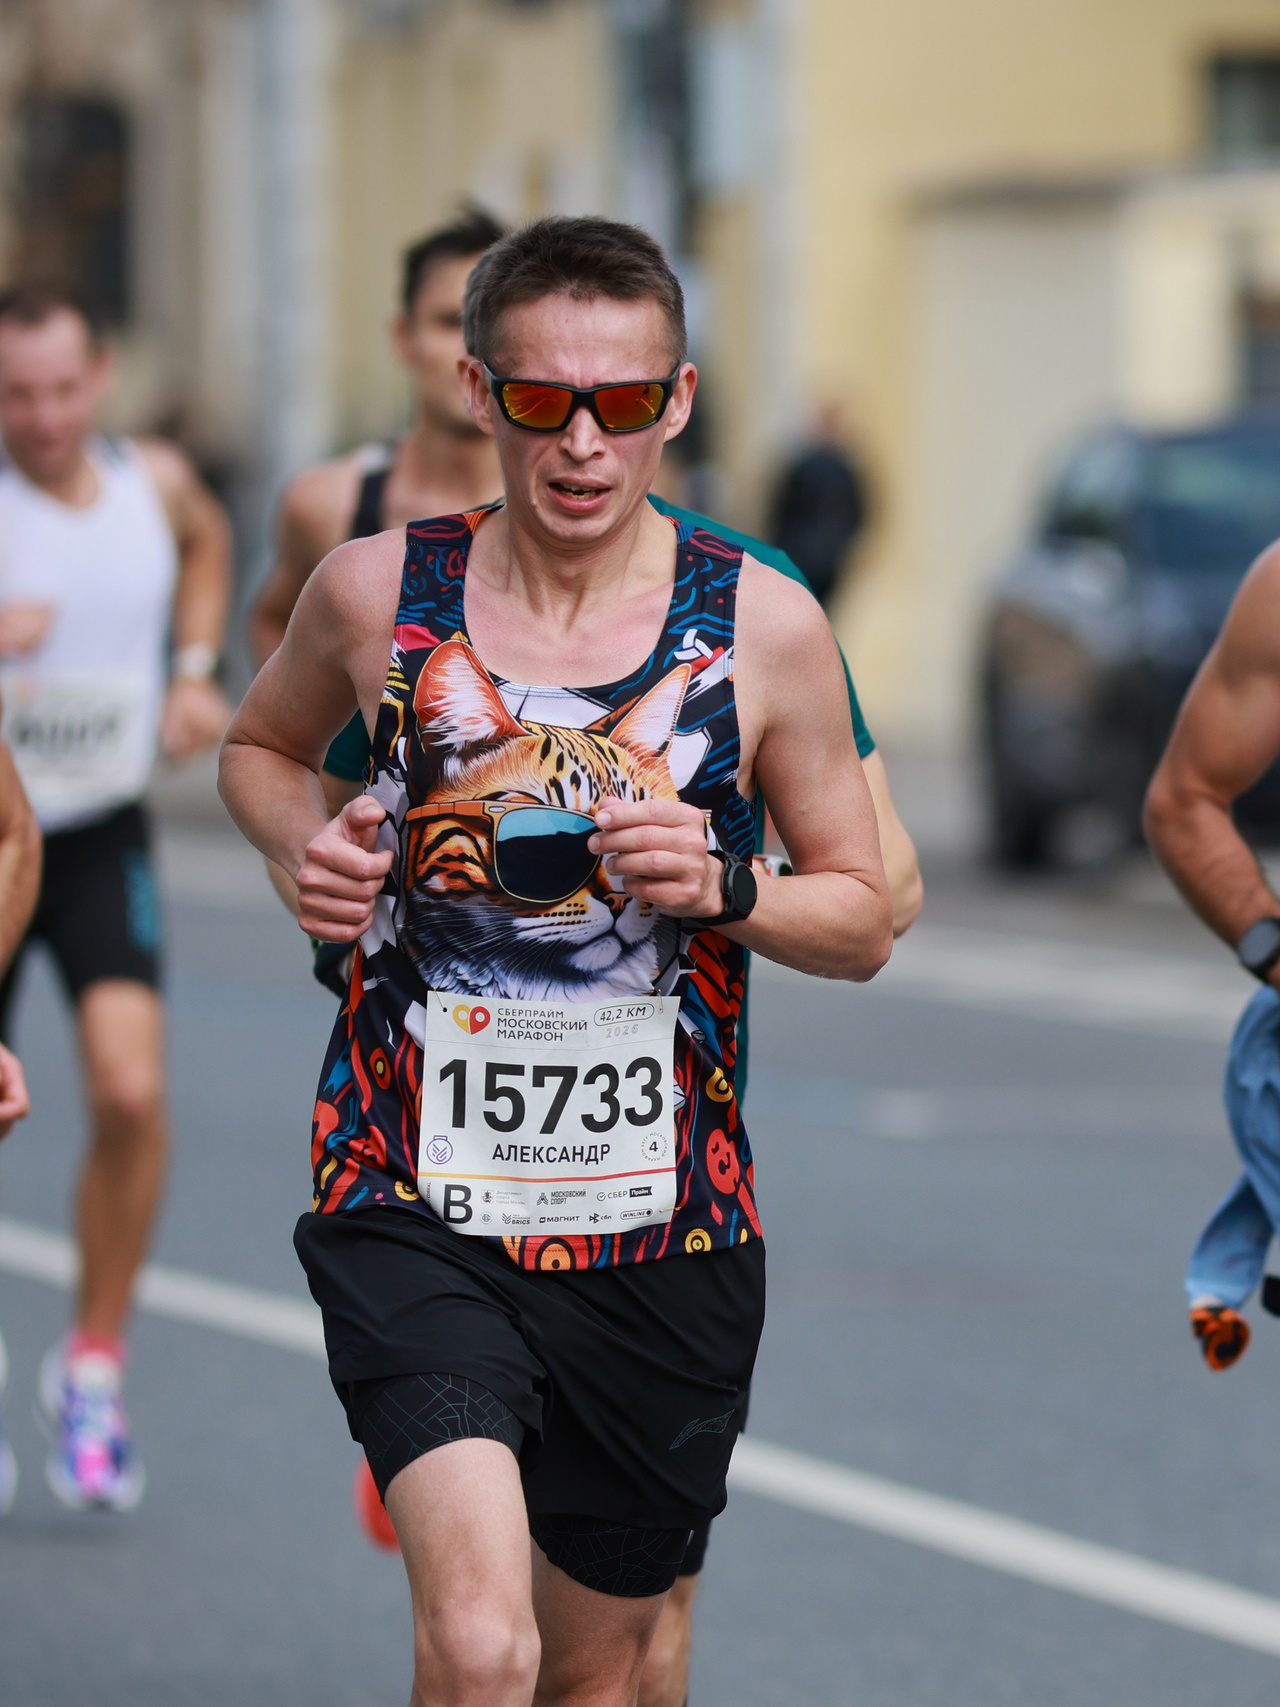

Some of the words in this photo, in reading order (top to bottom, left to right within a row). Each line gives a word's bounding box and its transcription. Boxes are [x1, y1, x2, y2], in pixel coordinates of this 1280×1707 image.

[497, 1008, 564, 1018] СБЕРПРАЙМ
[600, 1009, 621, 1022] 42,2
[497, 1018, 587, 1030] МОСКОВСКИЙ
[497, 1030, 563, 1041] МАРАФОН
[606, 1024, 639, 1039] 2026
[439, 1056, 663, 1135] 15733
[649, 1141, 658, 1152] 4
[492, 1144, 610, 1165] АЛЕКСАНДР
[608, 1190, 628, 1199] СБЕР
